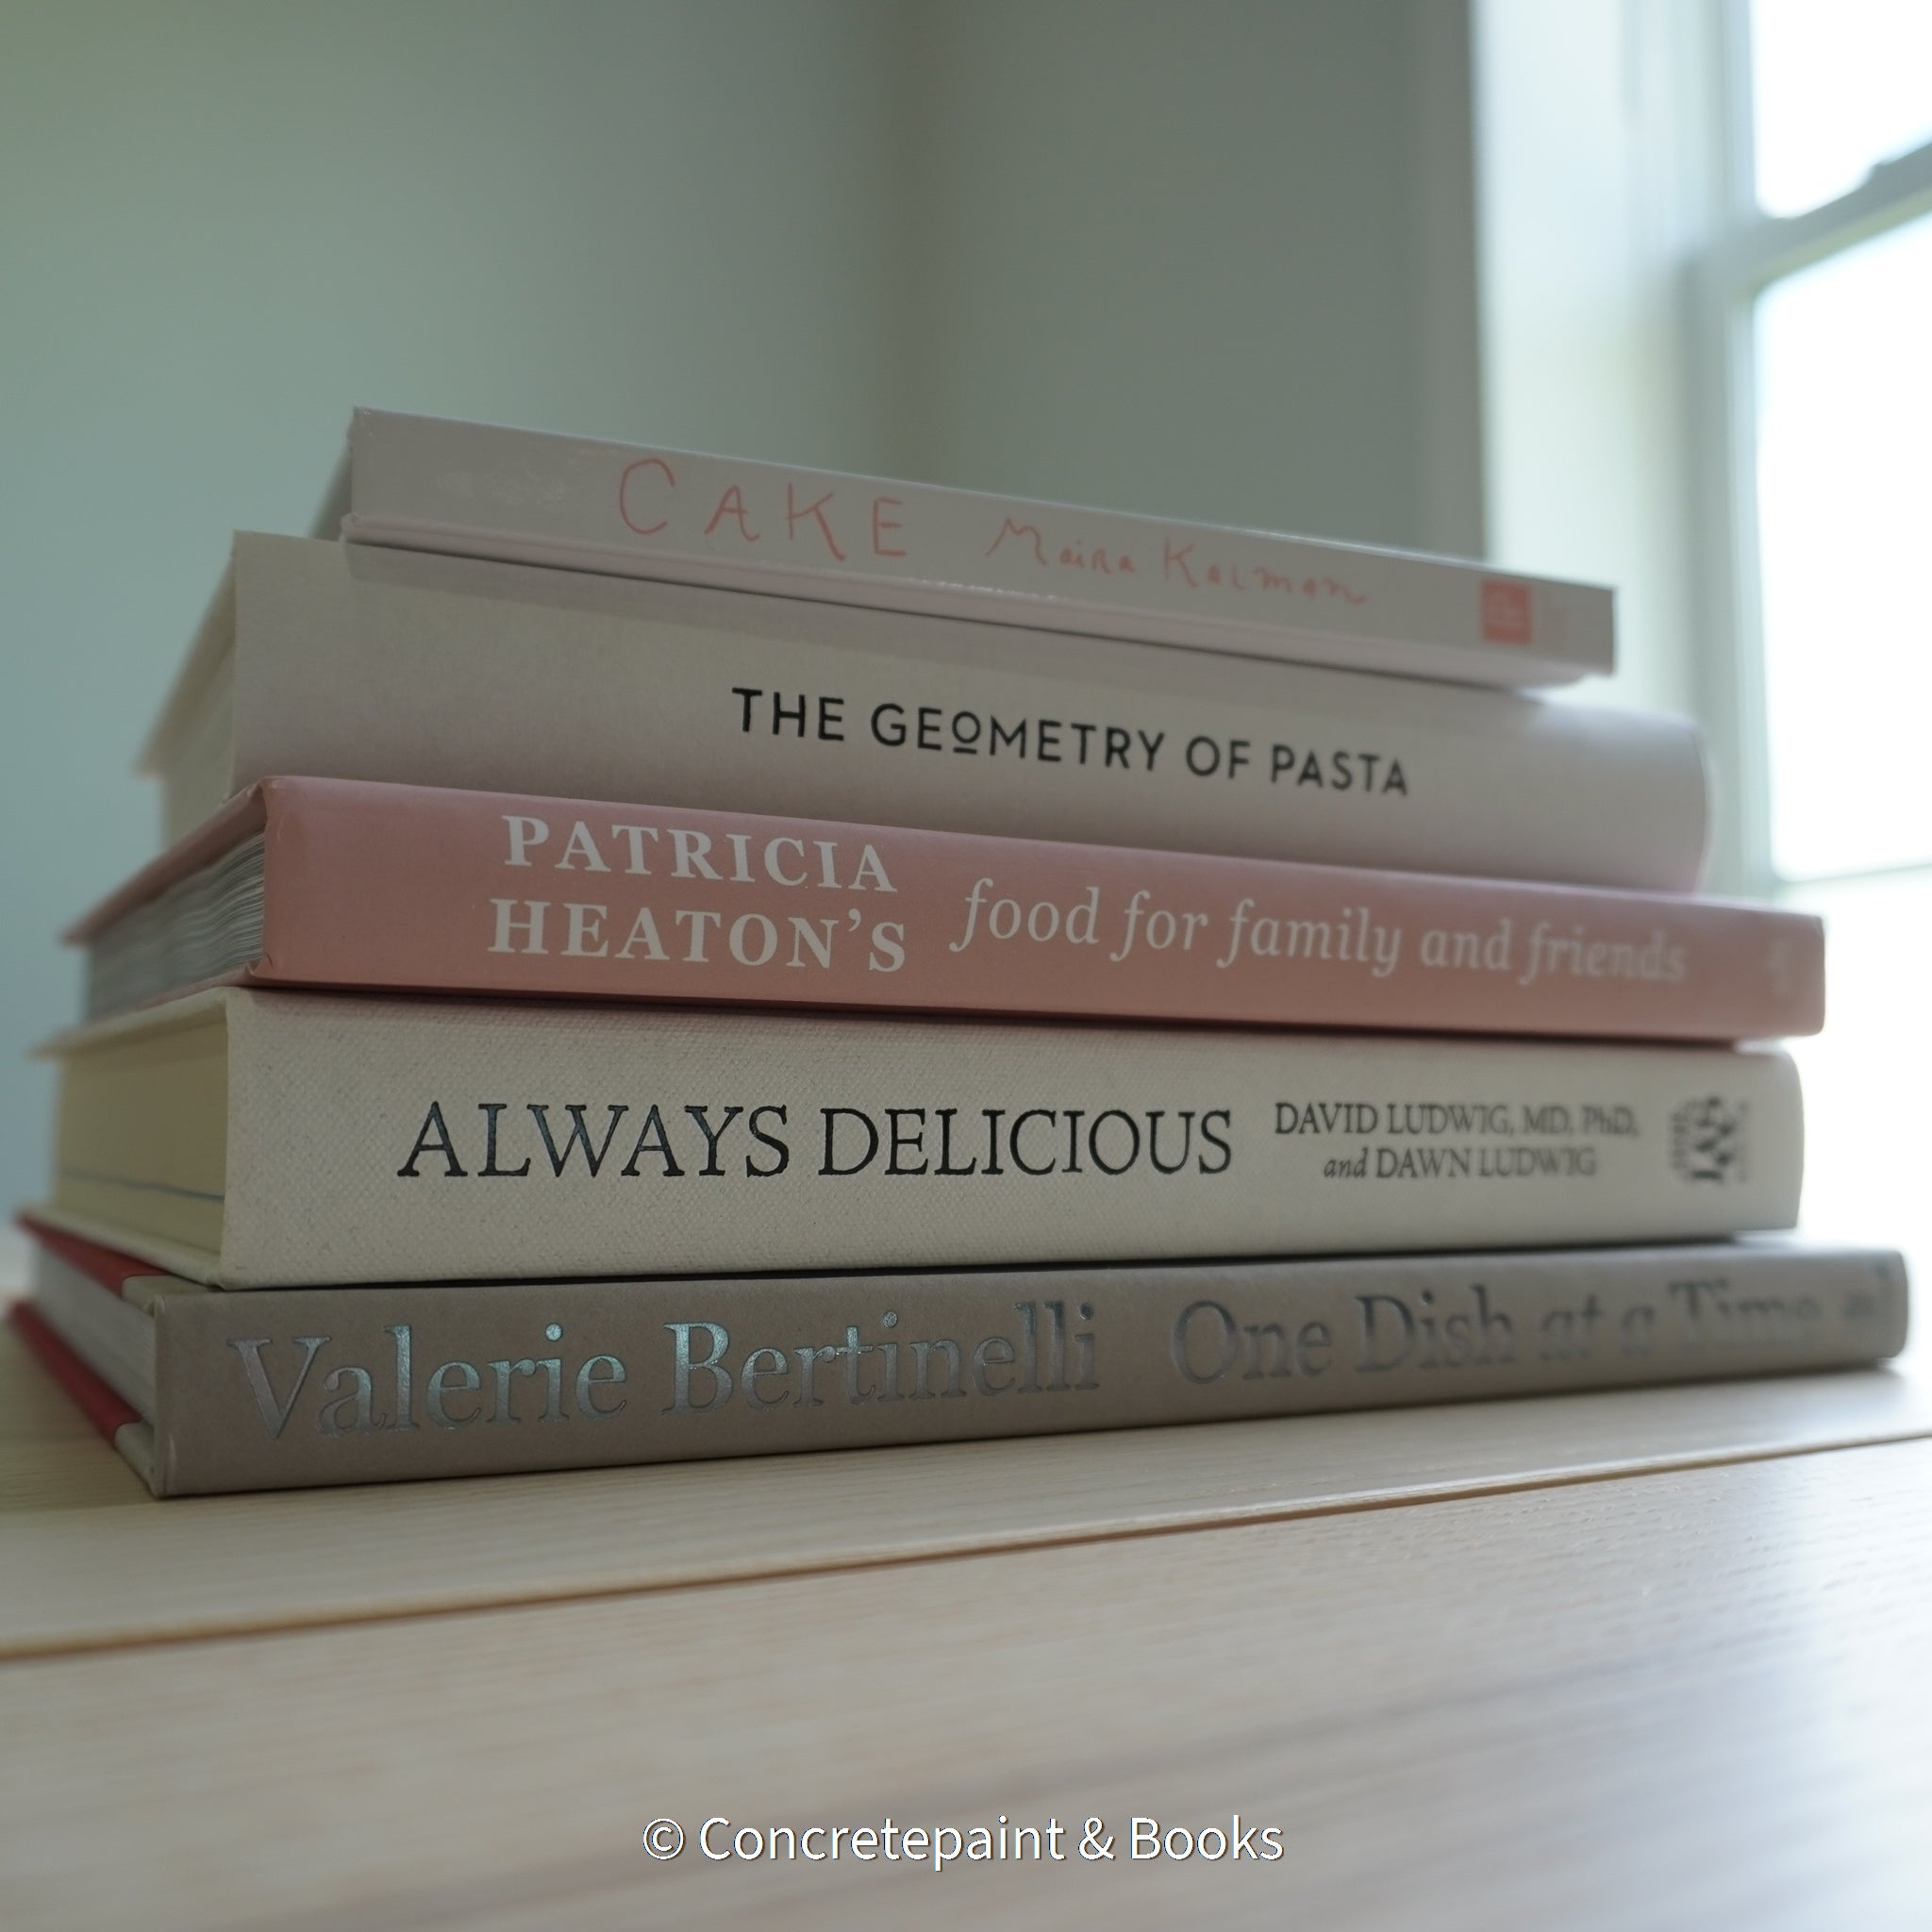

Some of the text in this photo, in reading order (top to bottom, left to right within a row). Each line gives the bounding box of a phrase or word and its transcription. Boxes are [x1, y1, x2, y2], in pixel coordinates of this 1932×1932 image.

[618, 458, 907, 561] CAKE
[1163, 536, 1368, 606] Kalman
[732, 688, 1409, 797] THE GEOMETRY OF PASTA
[502, 815, 898, 892] PATRICIA
[487, 898, 907, 974] HEATON'S
[948, 877, 1688, 987] food for family and friends
[396, 1101, 1233, 1179] ALWAYS DELICIOUS
[1274, 1101, 1378, 1136] DAVID
[1386, 1103, 1517, 1139] LUDWIG,
[1323, 1146, 1599, 1179] and DAWN LUDWIG
[226, 1324, 627, 1441] Valerie
[660, 1299, 1101, 1415] Bertinelli
[1169, 1299, 1333, 1384] One
[1355, 1283, 1517, 1374] Dish
